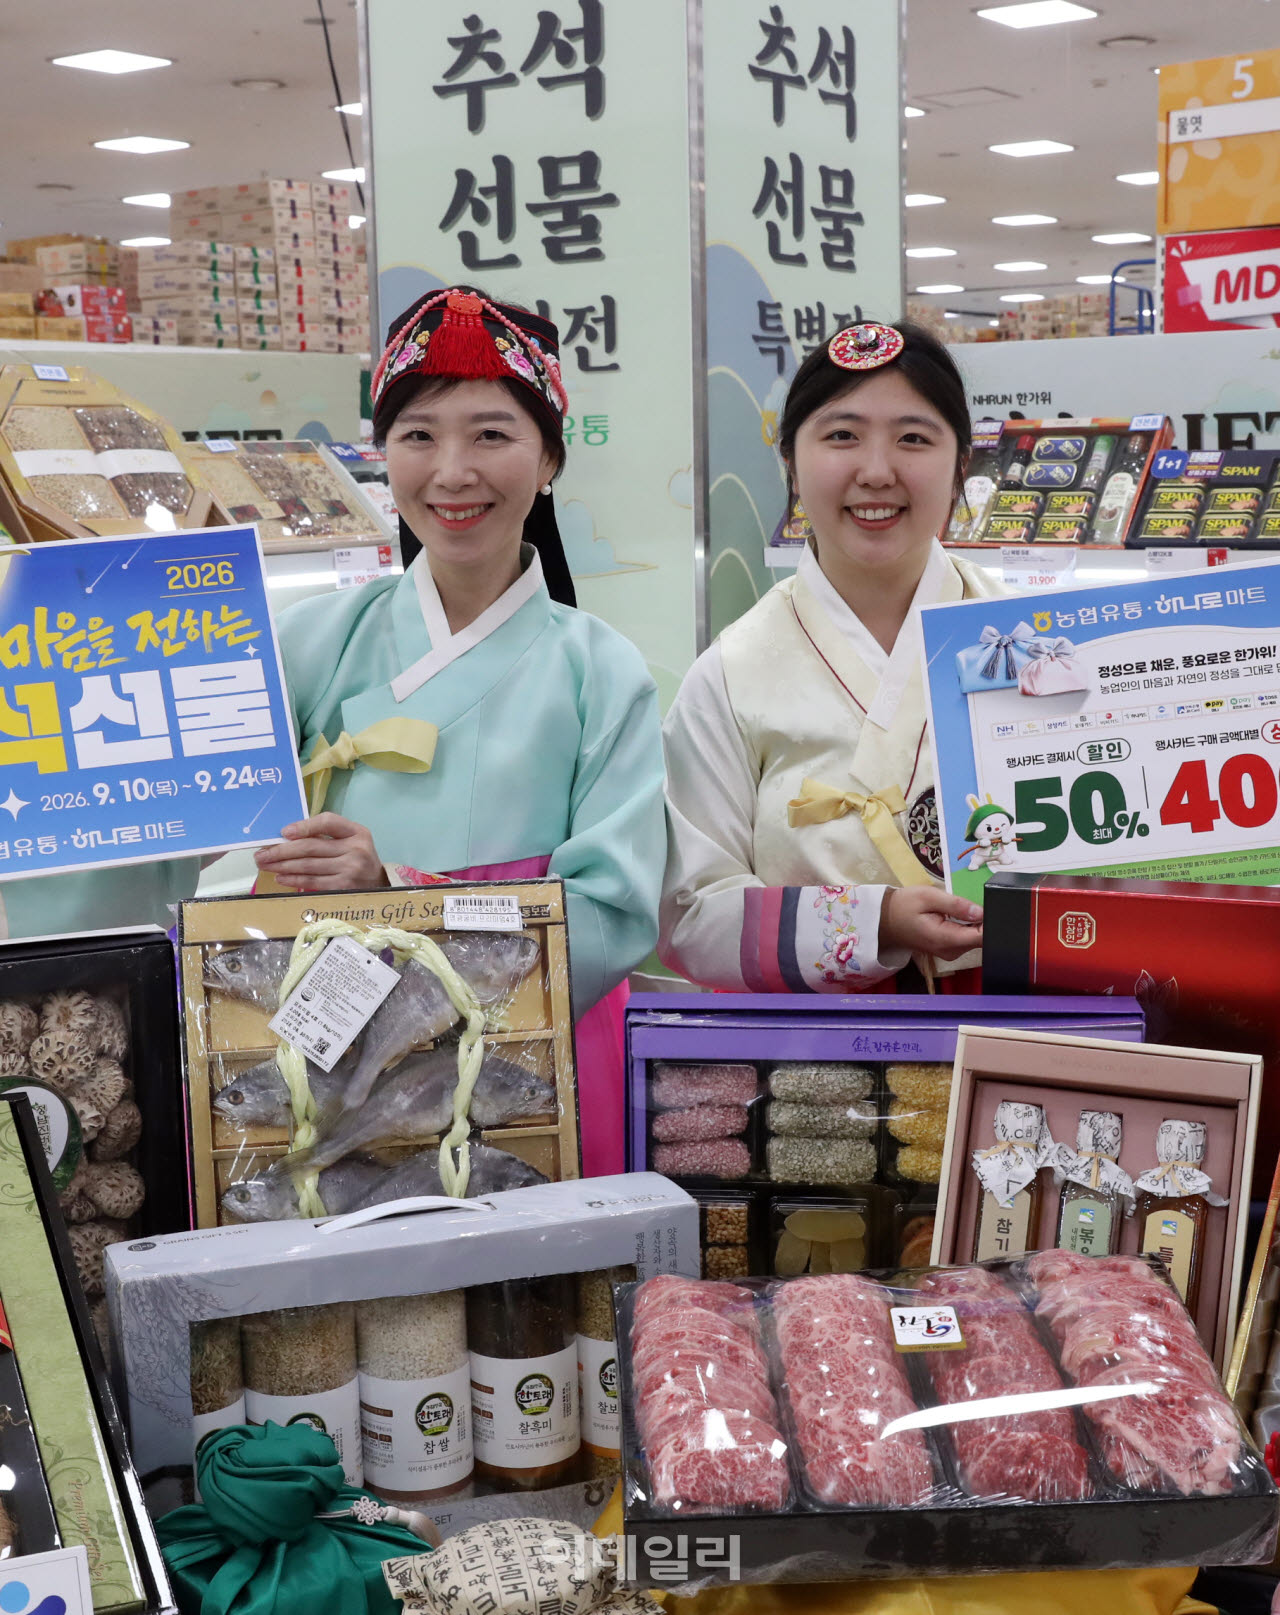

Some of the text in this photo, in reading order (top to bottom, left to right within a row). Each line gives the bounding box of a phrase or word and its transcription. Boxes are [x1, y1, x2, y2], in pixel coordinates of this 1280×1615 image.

[432, 0, 606, 135] 추석
[748, 5, 856, 142] 추석
[1231, 58, 1254, 99] 5
[1177, 115, 1202, 135] 물엿
[438, 150, 621, 271] 선물
[752, 152, 864, 273] 선물
[1016, 391, 1052, 406] 한가위
[1157, 456, 1183, 470] 1+1
[1221, 466, 1260, 477] SPAM
[999, 495, 1032, 505] SPAM
[1052, 495, 1085, 505] SPAM
[1158, 492, 1195, 502] SPAM
[1216, 492, 1252, 502] SPAM
[991, 520, 1023, 530] SPAM
[1042, 520, 1075, 530] SPAM
[1149, 519, 1185, 529] SPAM
[1206, 519, 1242, 529] SPAM
[165, 561, 235, 591] 2026
[1028, 576, 1057, 585] 31,900
[0, 604, 262, 673] 마음을 전하는
[1098, 645, 1277, 679] 정성으로 채운, 풍요로운 한가위!
[1100, 680, 1140, 695] 농업인의
[1143, 676, 1174, 690] 마음과
[1177, 672, 1207, 685] 자연의
[1210, 668, 1241, 682] 정성을
[1243, 663, 1274, 678] 그대로
[996, 725, 1014, 733] NH
[1046, 720, 1069, 730] 삼성카드
[1155, 736, 1197, 751] 행사카드
[1197, 733, 1218, 747] 구매
[1219, 728, 1260, 744] 금액대별
[1006, 750, 1076, 769] 행사카드 결제시
[1092, 827, 1113, 841] 최대
[301, 906, 375, 924] Premium
[381, 901, 416, 928] Gift
[520, 905, 550, 918] 동보관
[995, 1218, 1013, 1251] 참기
[598, 1401, 619, 1415] 찰보
[519, 1417, 552, 1435] 찰흑미
[423, 1437, 450, 1456] 찹쌀
[68, 1480, 91, 1534] Premium
[434, 1513, 453, 1526] SET
